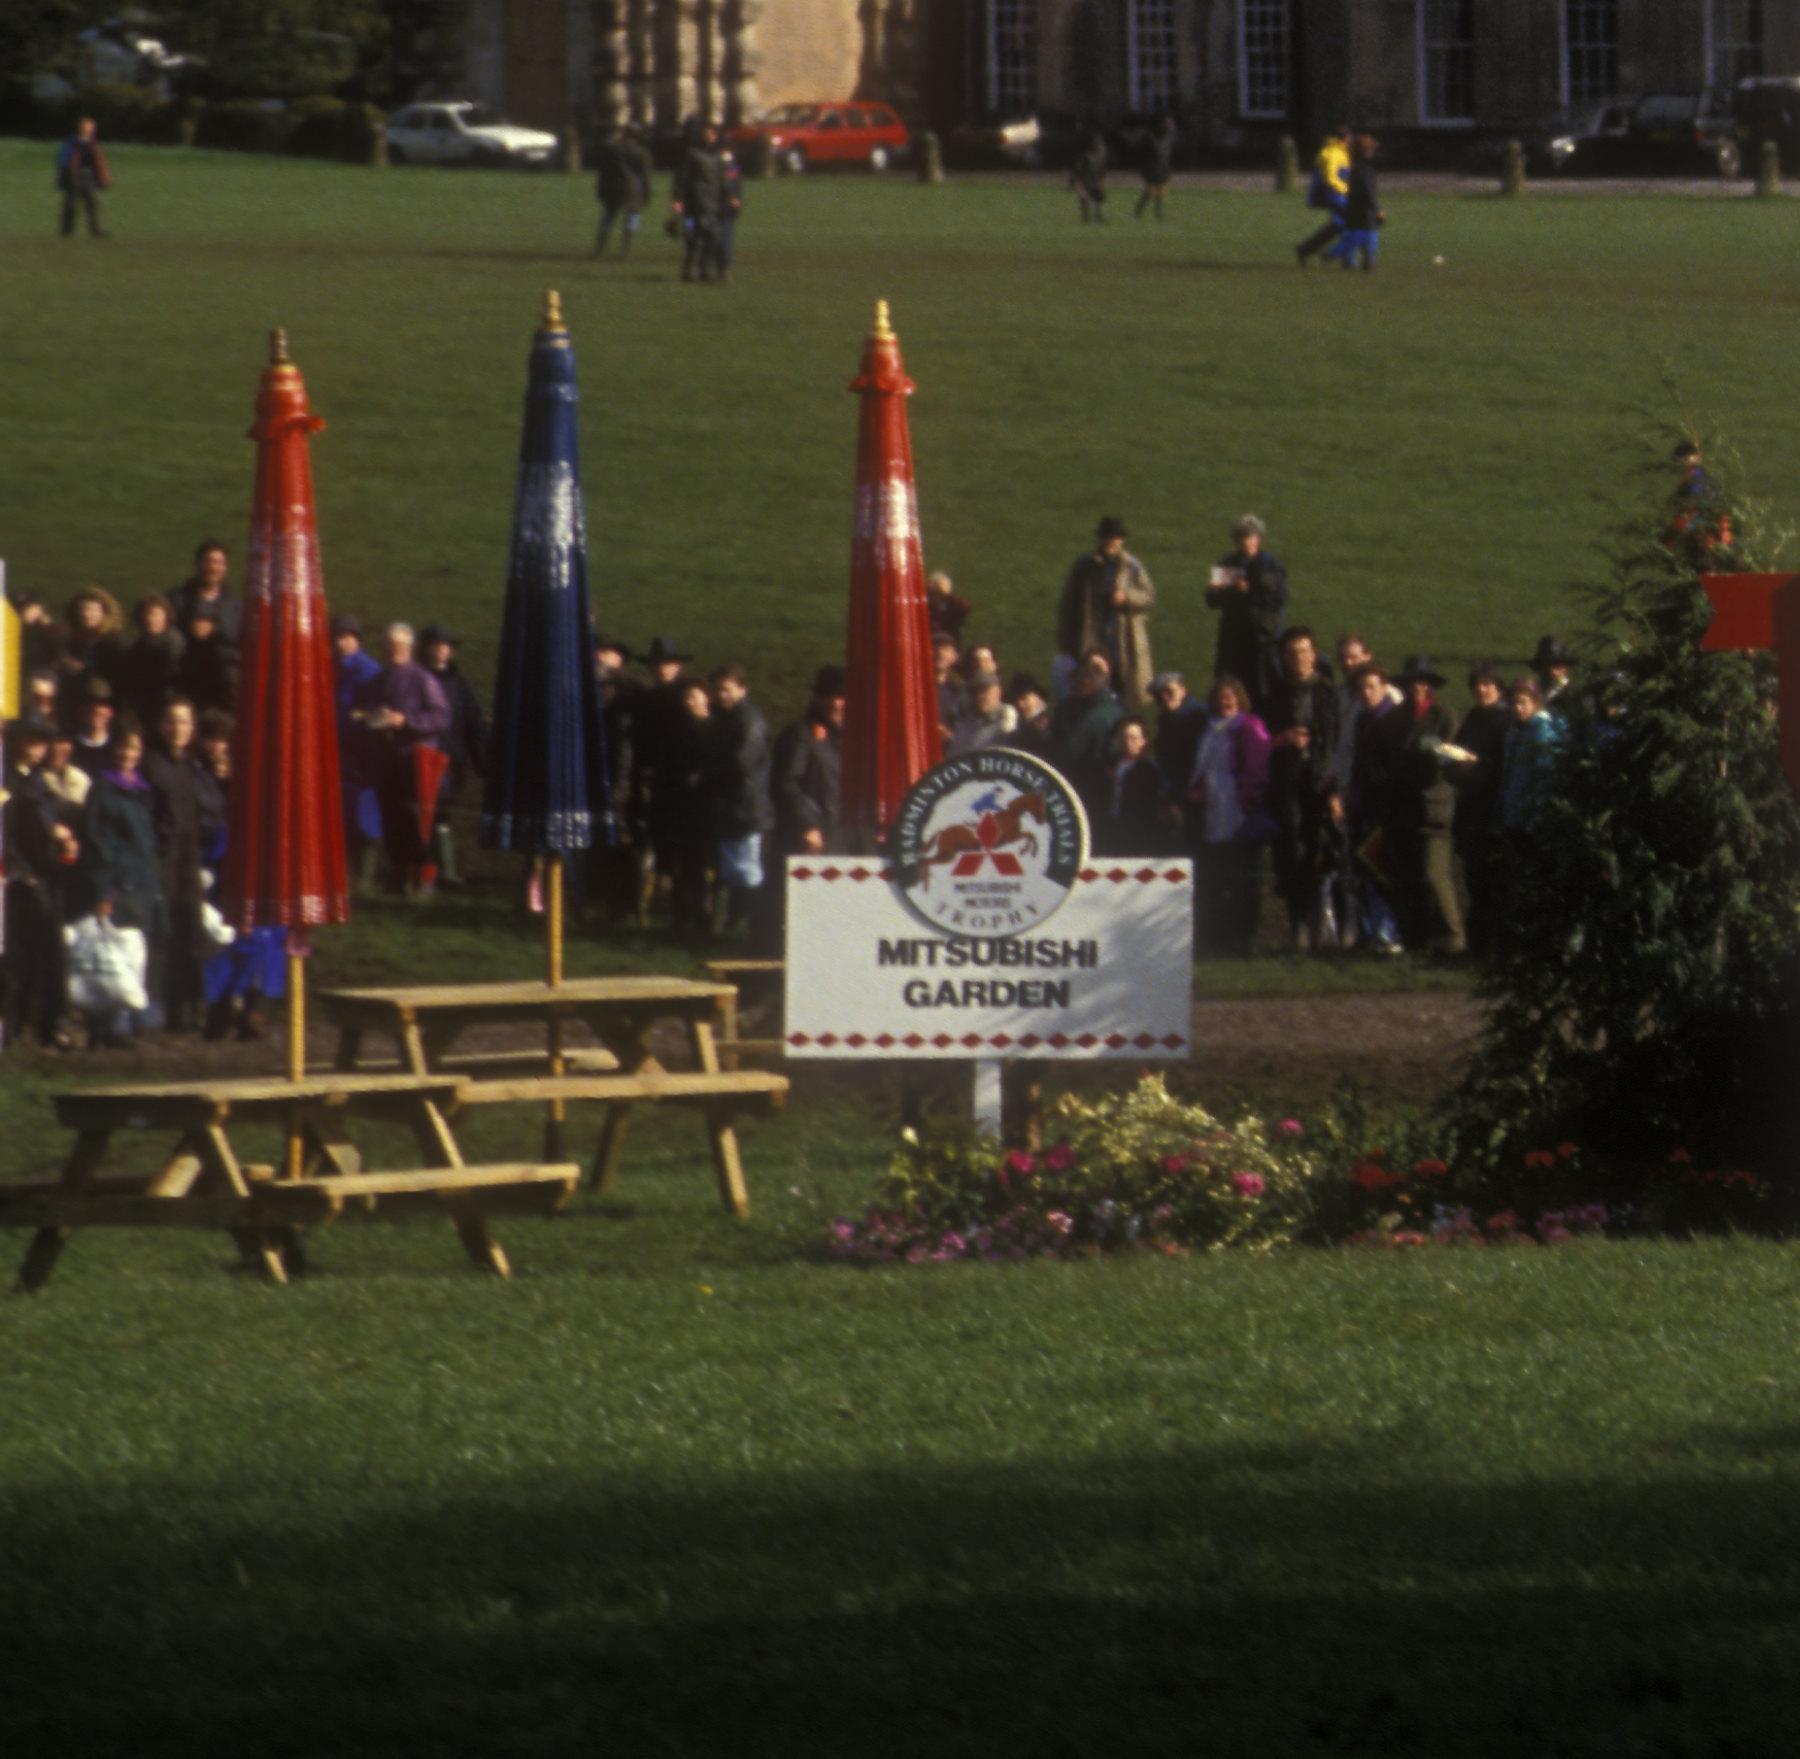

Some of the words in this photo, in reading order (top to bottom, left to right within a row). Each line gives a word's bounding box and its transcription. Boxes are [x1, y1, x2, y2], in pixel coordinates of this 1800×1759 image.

[980, 757, 1045, 790] HORSE
[1048, 791, 1076, 865] TRIALS
[936, 902, 1039, 929] TROPHY
[878, 939, 1098, 968] MITSUBISHI
[903, 980, 1071, 1008] GARDEN
